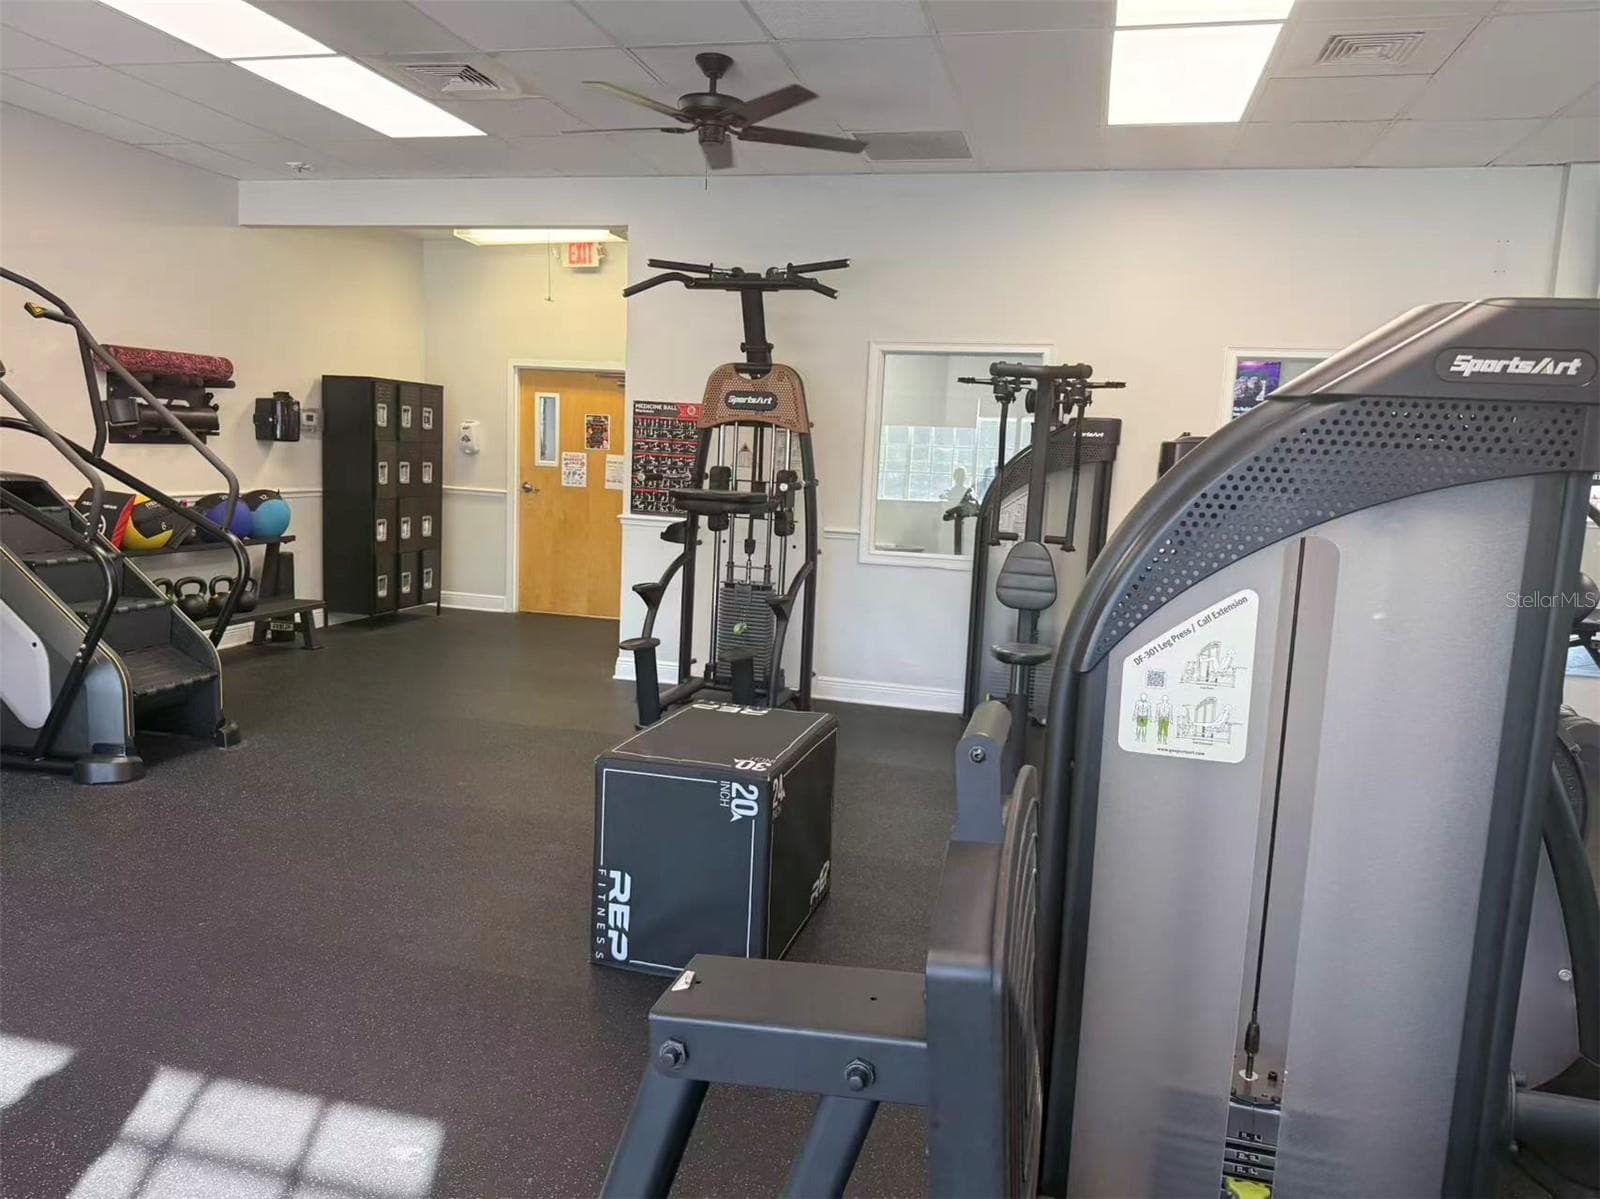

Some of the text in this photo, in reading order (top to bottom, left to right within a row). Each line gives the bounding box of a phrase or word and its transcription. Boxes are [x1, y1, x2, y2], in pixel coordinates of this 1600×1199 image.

[568, 242, 592, 265] EXIT
[1450, 354, 1582, 376] SportsArt
[728, 395, 773, 405] SportsArt
[1133, 646, 1160, 666] DF-301
[1160, 641, 1174, 651] Leg
[1170, 627, 1192, 643] Press
[1196, 614, 1213, 628] Calf
[1212, 596, 1248, 620] Extension
[720, 780, 731, 808] INCH
[731, 782, 759, 817] 20
[595, 868, 607, 960] FITNESS
[608, 869, 631, 961] REP
